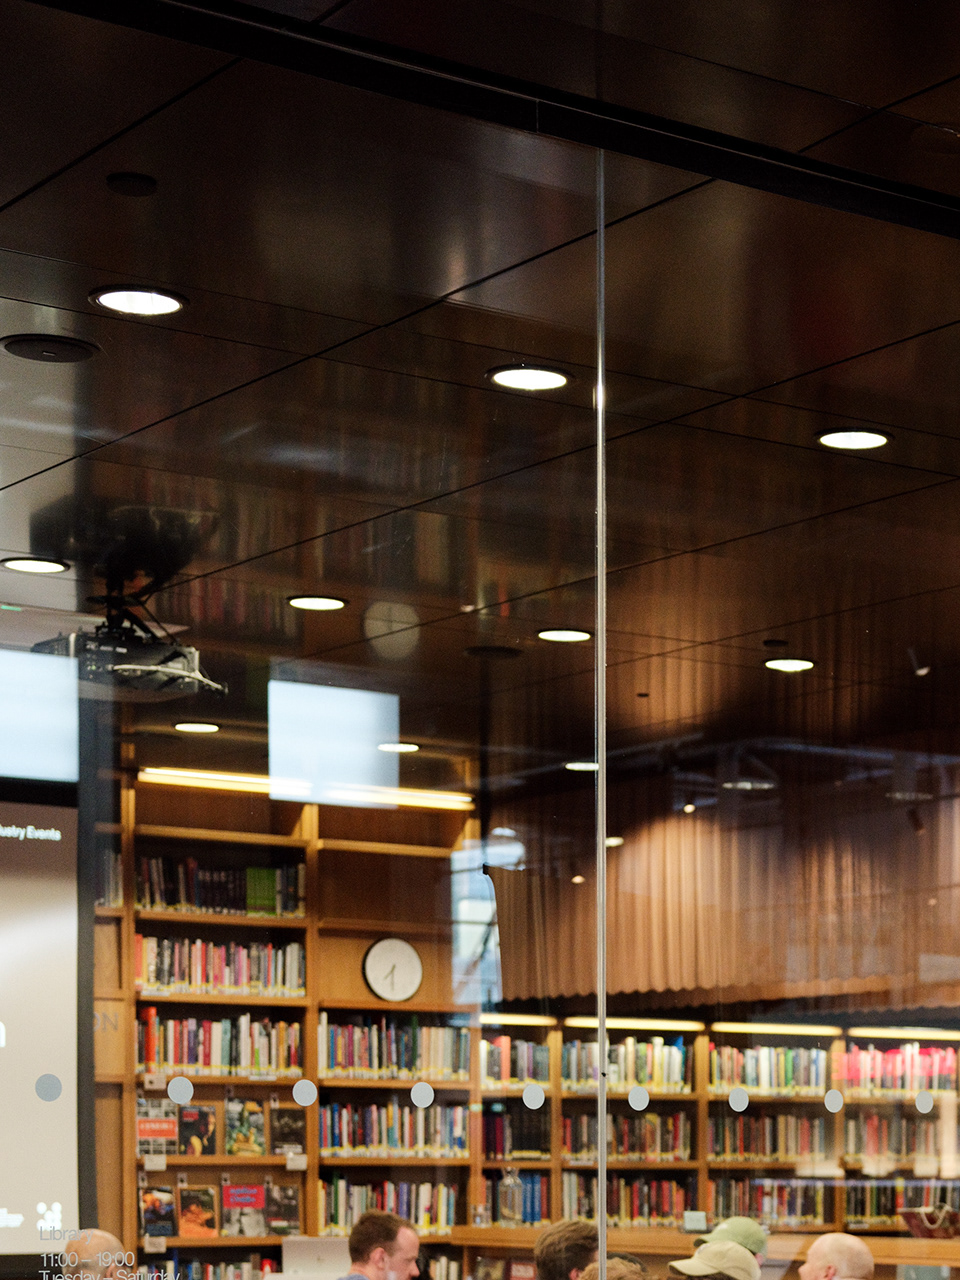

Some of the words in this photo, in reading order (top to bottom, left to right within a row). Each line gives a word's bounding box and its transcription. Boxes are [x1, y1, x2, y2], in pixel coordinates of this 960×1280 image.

[0, 824, 26, 841] ustry
[26, 825, 62, 841] Events
[39, 1226, 94, 1244] Library
[40, 1251, 78, 1267] 11:00
[96, 1251, 135, 1267] 19:00
